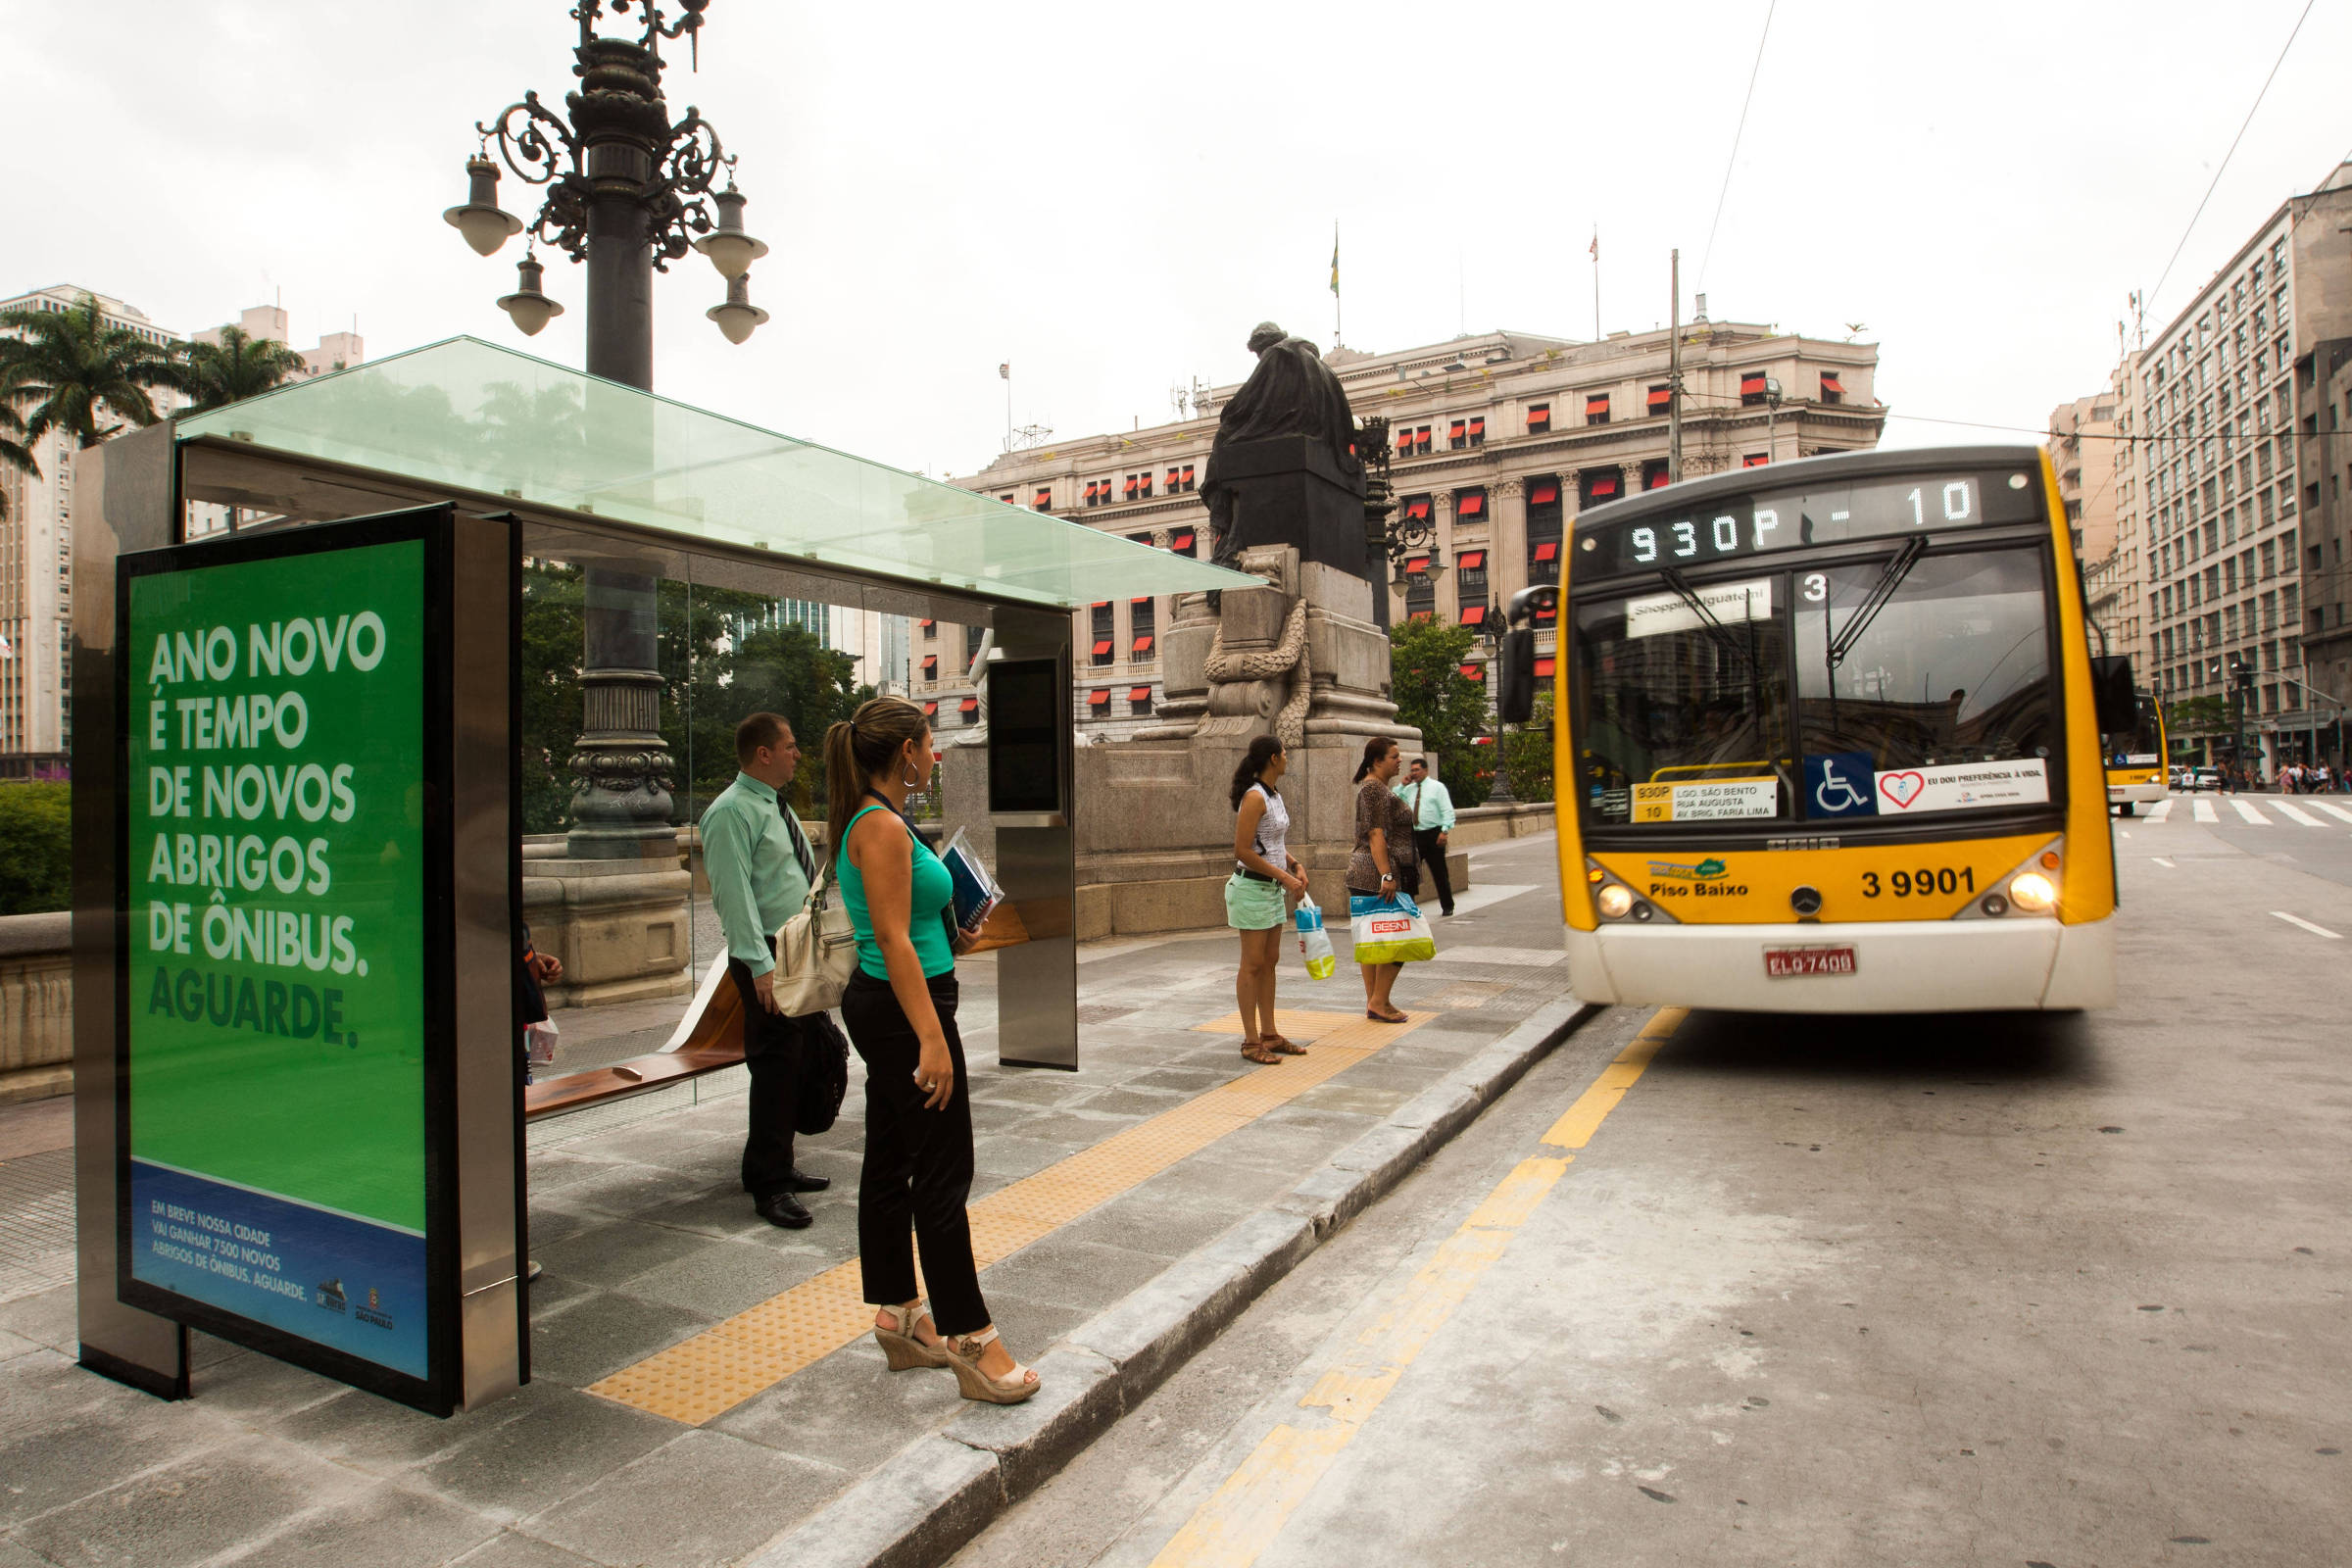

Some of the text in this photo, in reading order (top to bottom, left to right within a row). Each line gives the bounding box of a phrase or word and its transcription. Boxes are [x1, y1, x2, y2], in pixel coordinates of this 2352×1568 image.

[1632, 509, 1779, 563] 930P
[1907, 480, 1972, 525] 10
[1803, 573, 1827, 602] 3
[148, 611, 387, 685] ANO NOVO
[148, 683, 309, 751] É TEMPO
[148, 762, 357, 823] DE NOVOS
[1638, 786, 1671, 799] 930P
[1700, 786, 1721, 798] SÃO
[1723, 786, 1757, 796] BENTO
[1697, 798, 1744, 808] AUGUSTA
[1927, 776, 1938, 785] EU
[1939, 775, 1956, 785] DOU
[1645, 807, 1662, 819] 10
[1717, 808, 1744, 817] FARIA
[1747, 807, 1770, 816] LIMA
[148, 832, 331, 896] ABRIGOS
[1649, 881, 1748, 897] Piso Baixo
[1862, 865, 1975, 899] 3 9901
[148, 888, 368, 978] DE ÔNIBUS.
[1373, 918, 1409, 932] BESNI
[148, 965, 359, 1050] AGUARDE.
[151, 1200, 271, 1248] EM BREVE NOSSA CIDADE
[151, 1219, 281, 1272] VAI GANHAR 7500 NOVOS
[152, 1240, 308, 1302] ABRIGOS DE ÔNIBUS. AGUARDE.
